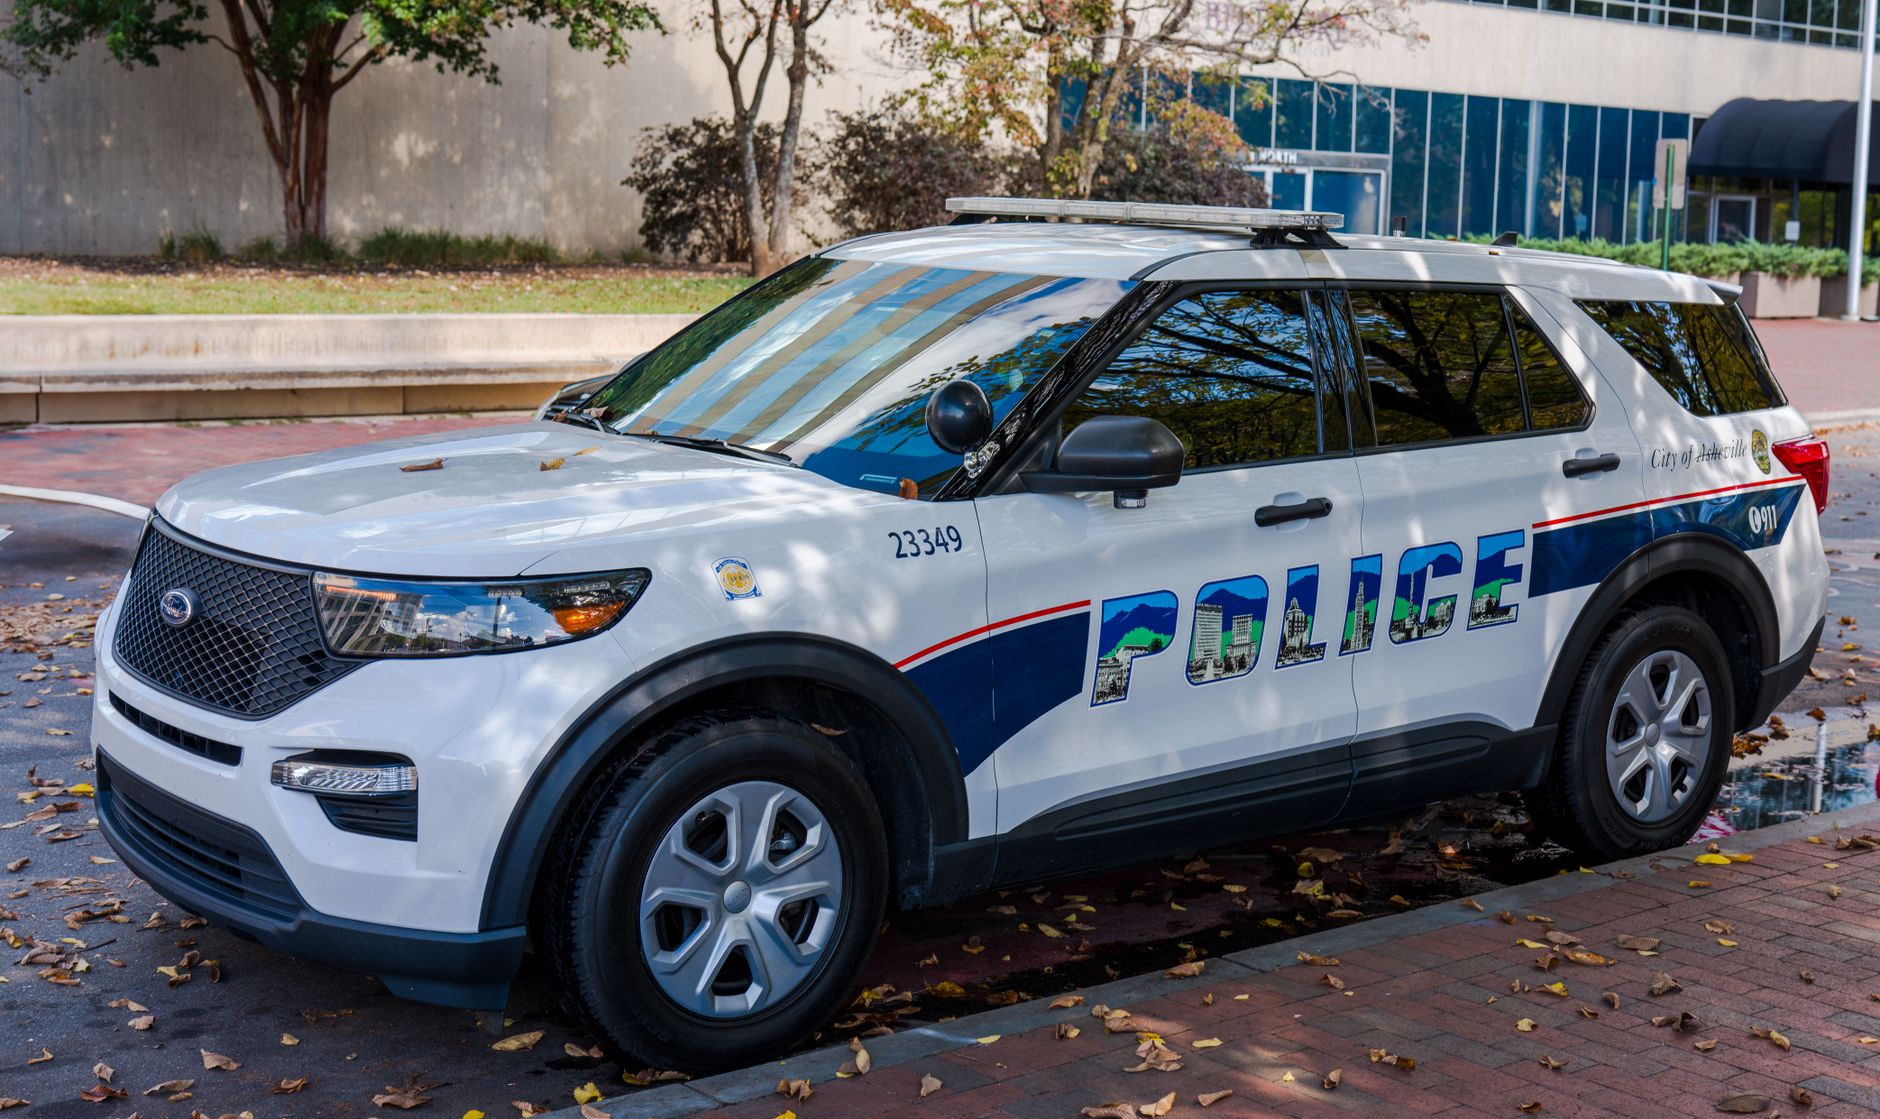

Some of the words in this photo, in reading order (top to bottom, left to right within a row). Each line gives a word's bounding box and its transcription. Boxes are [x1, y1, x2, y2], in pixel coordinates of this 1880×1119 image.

[1260, 150, 1297, 165] NORTH
[1651, 447, 1678, 472] City
[1681, 443, 1694, 470] of
[1694, 437, 1748, 463] Asheville
[1760, 504, 1778, 531] 911
[888, 525, 963, 559] 23349
[1090, 528, 1525, 708] POLICE
